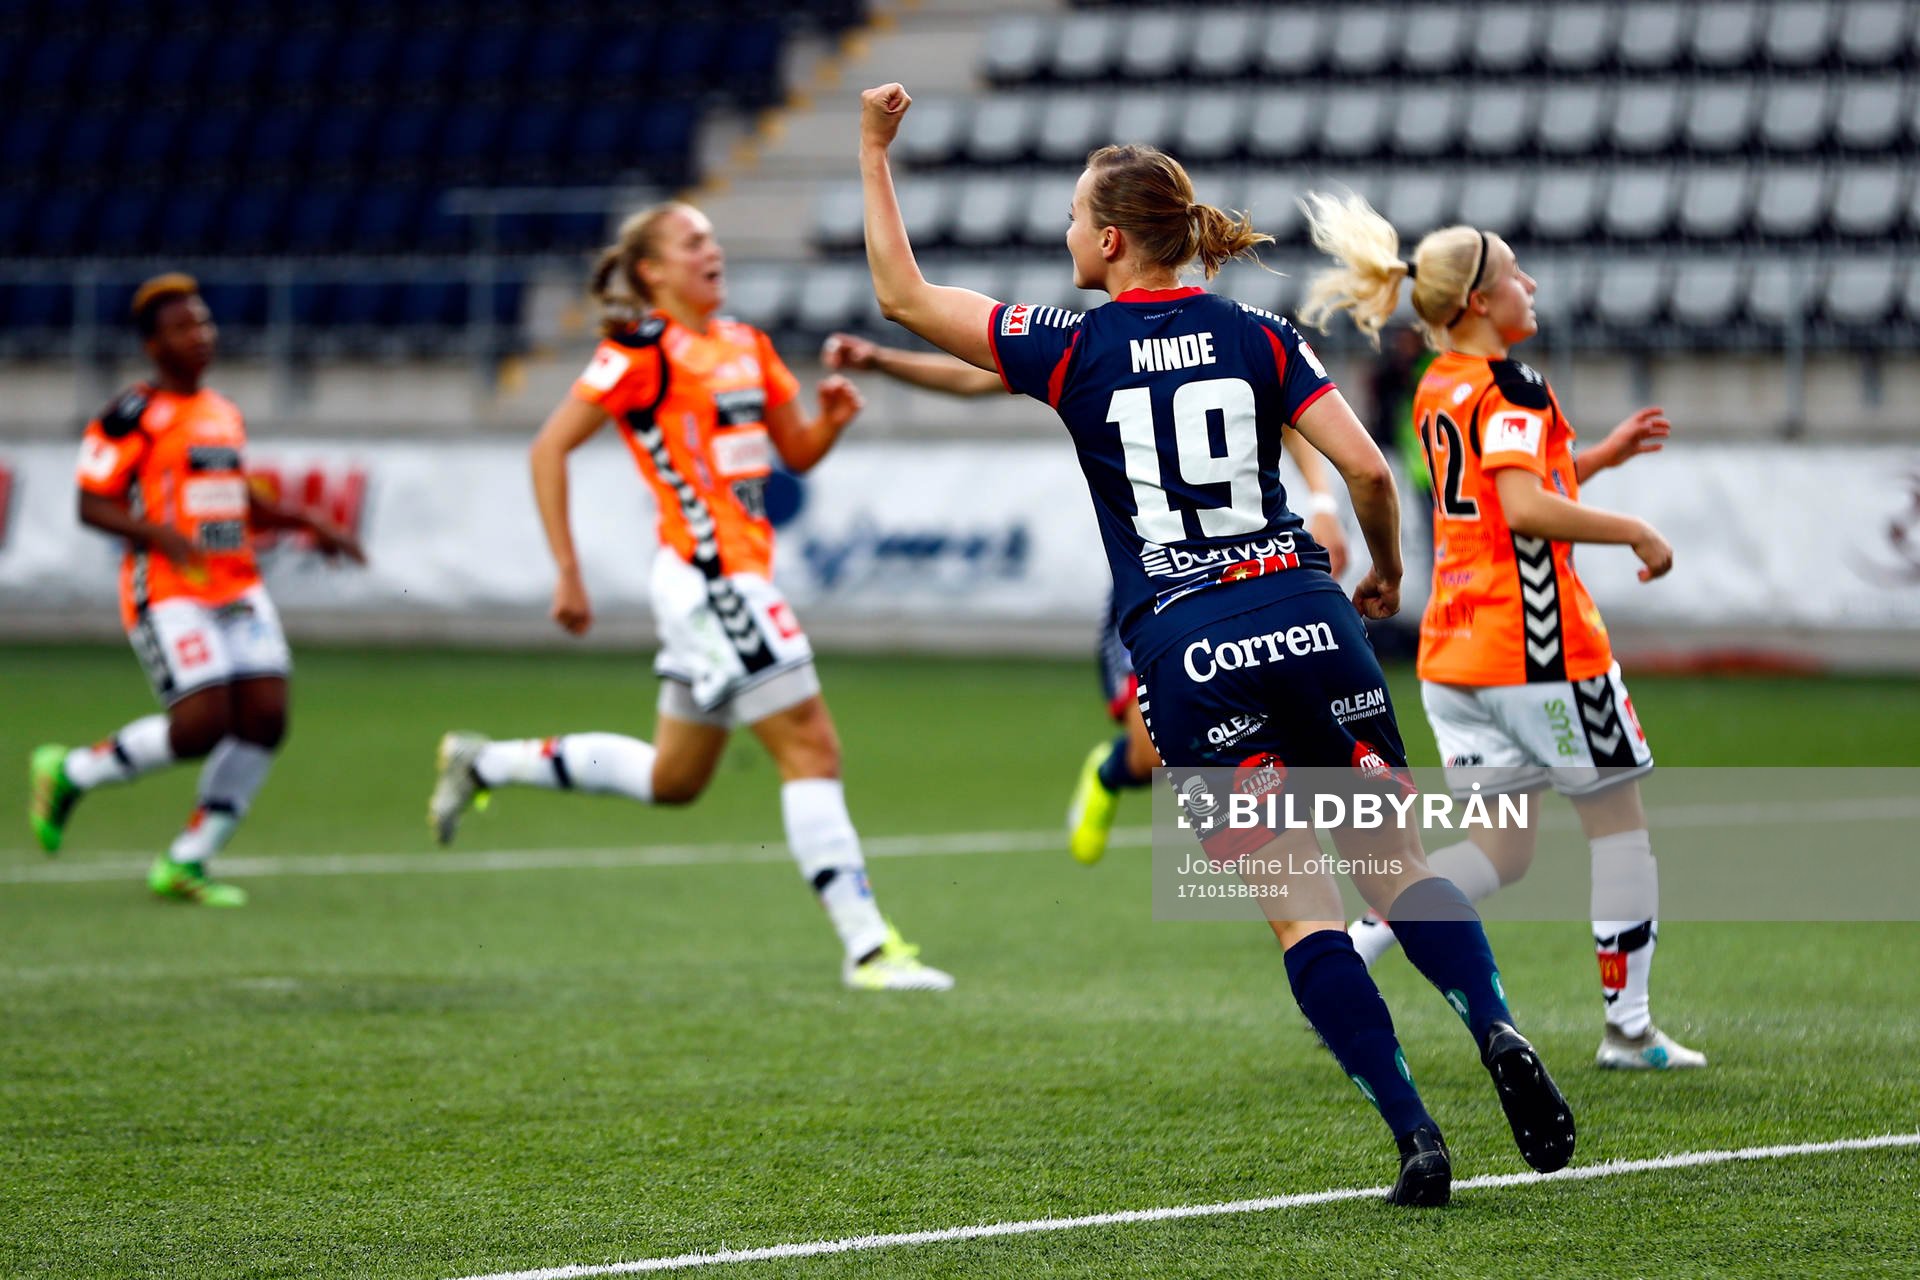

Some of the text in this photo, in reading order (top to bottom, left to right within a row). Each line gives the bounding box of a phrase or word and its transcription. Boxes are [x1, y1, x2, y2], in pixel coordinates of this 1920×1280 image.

[1129, 331, 1217, 373] MINDE
[1105, 377, 1268, 544] 19
[1420, 408, 1481, 519] 12
[1184, 622, 1339, 683] Corren
[1330, 687, 1385, 717] QLEAN
